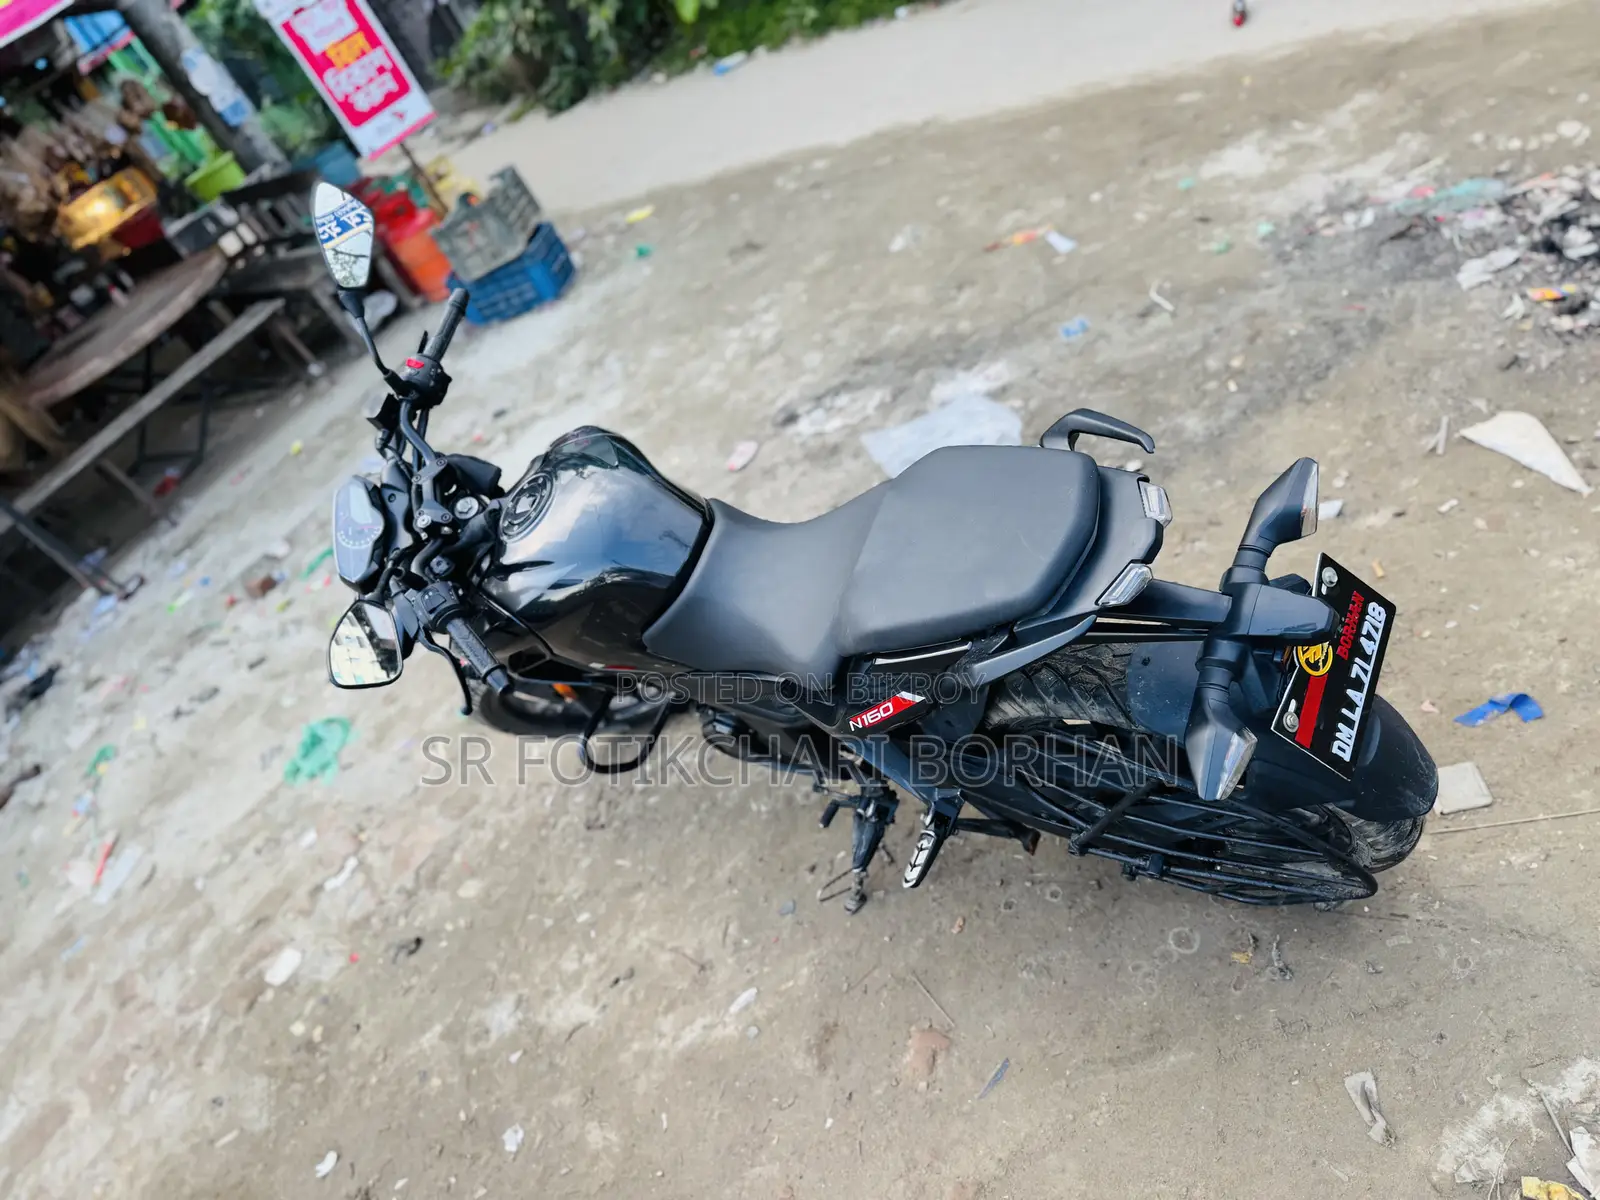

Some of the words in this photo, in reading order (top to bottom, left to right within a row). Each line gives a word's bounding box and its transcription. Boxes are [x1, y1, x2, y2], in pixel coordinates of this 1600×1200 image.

[1337, 591, 1364, 659] BORHAN
[849, 702, 893, 732] N160
[1341, 689, 1365, 720] LA
[1332, 722, 1356, 762] DM
